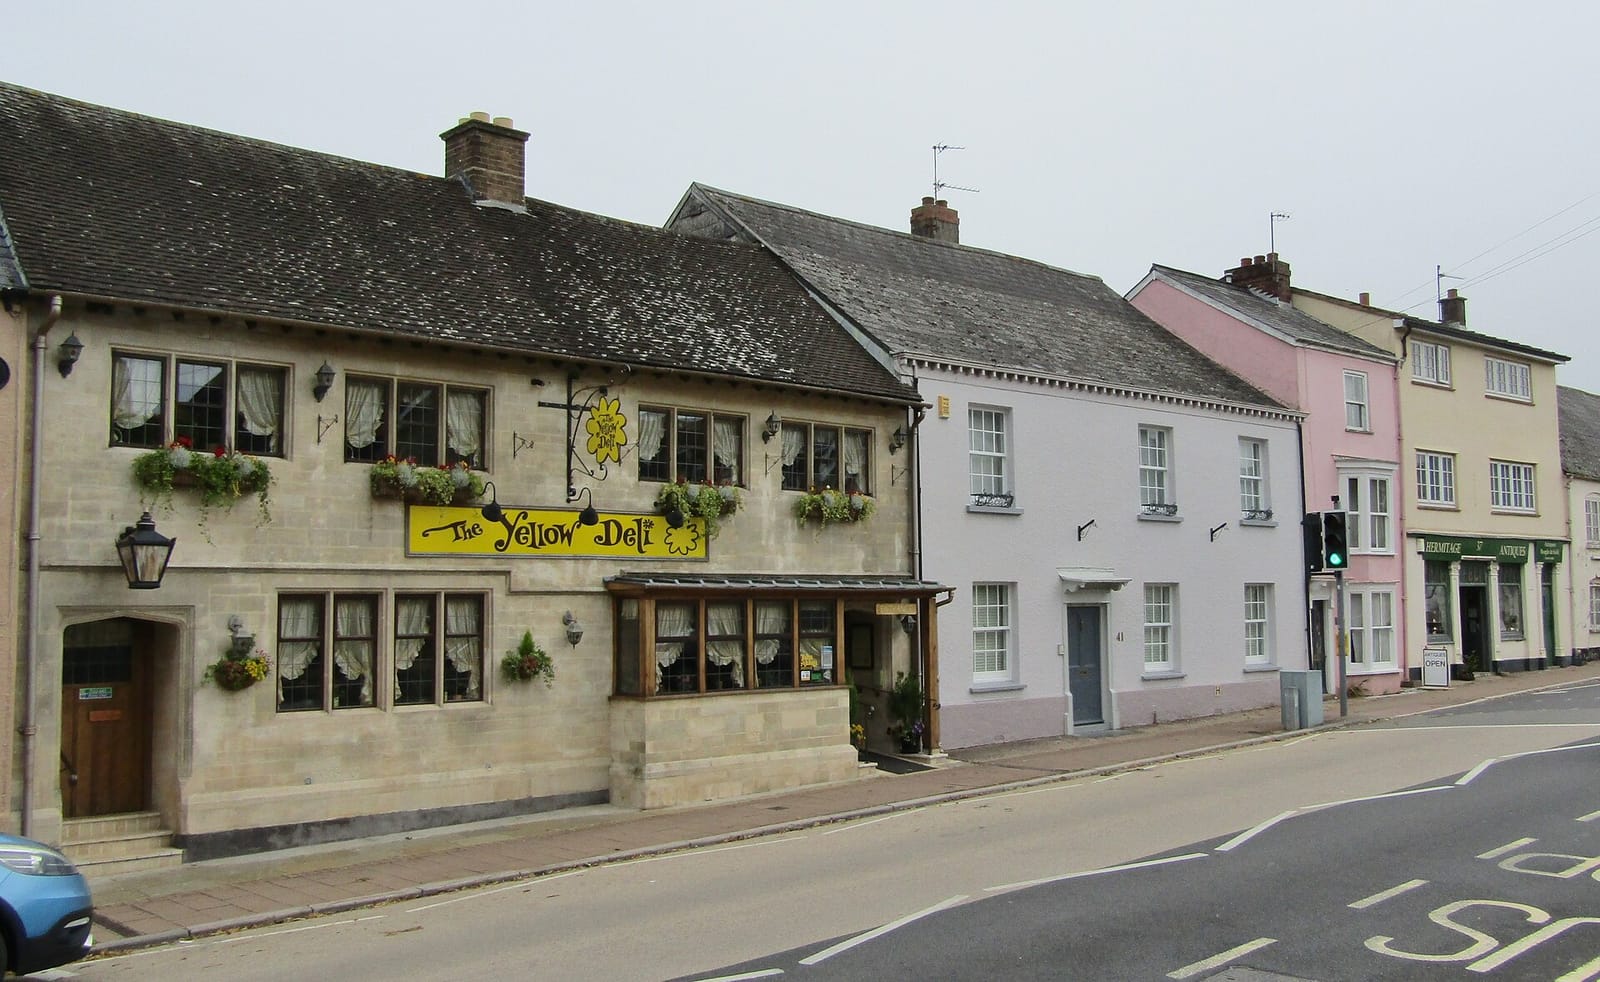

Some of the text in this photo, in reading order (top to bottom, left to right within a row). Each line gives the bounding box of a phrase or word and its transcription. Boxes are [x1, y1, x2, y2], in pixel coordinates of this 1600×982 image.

[598, 434, 615, 451] Deli
[422, 511, 655, 553] The Yellow Deli
[1426, 541, 1462, 553] HERMITAGE
[1499, 545, 1526, 558] ANTIQUES
[1116, 632, 1124, 641] 41
